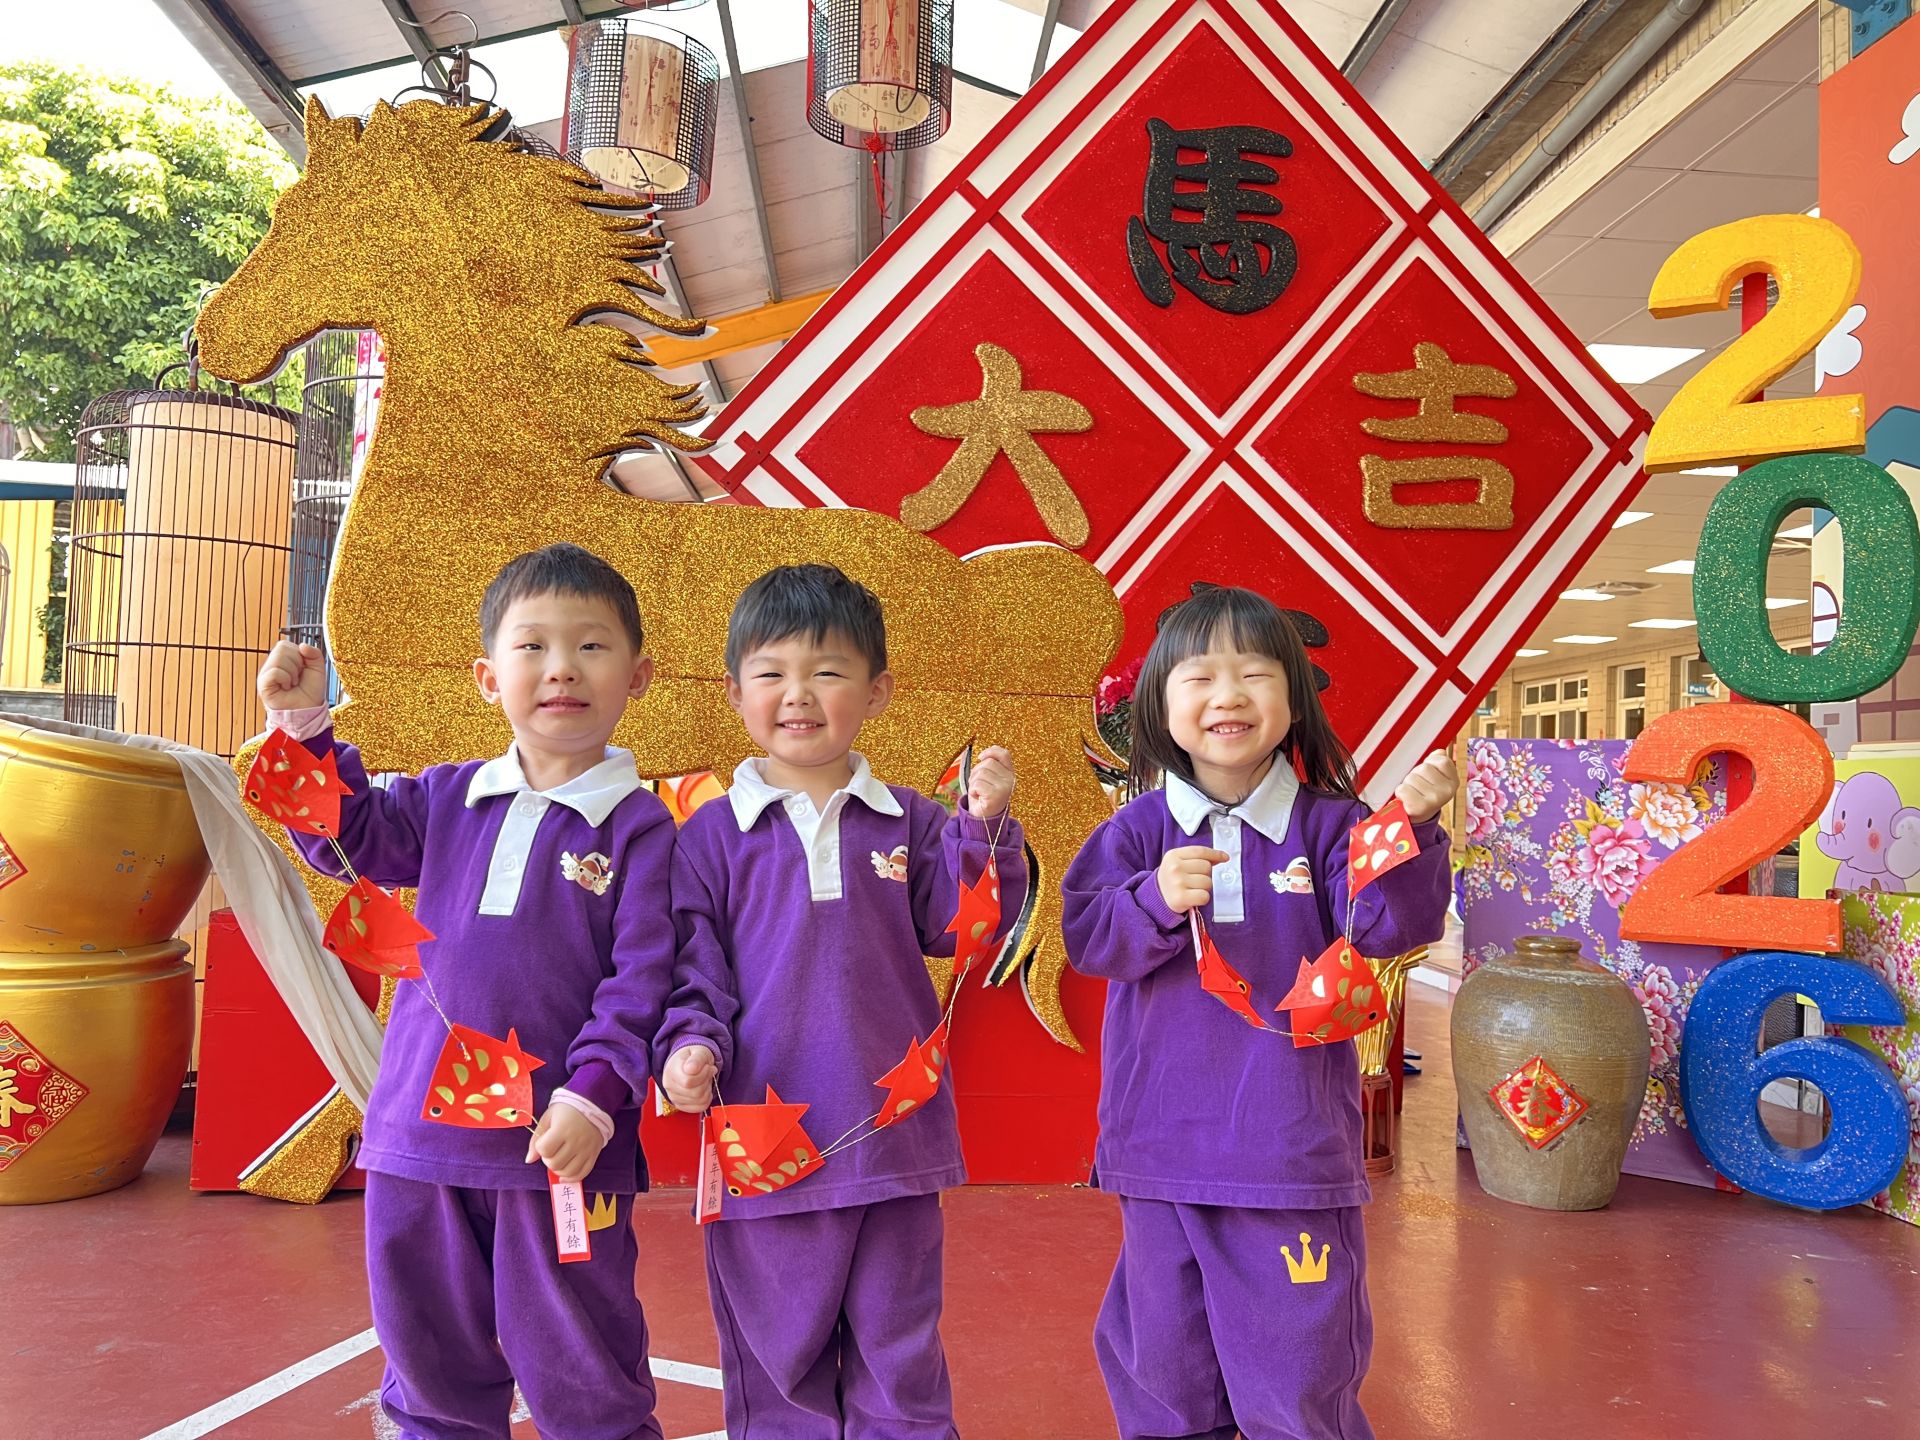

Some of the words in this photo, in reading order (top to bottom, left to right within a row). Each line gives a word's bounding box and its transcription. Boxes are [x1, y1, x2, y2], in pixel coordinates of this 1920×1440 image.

[1127, 117, 1297, 315] 馬
[900, 342, 1094, 549] 大
[1352, 342, 1517, 530] 吉
[1518, 1080, 1560, 1127] 春
[561, 1185, 581, 1249] 年年有餘
